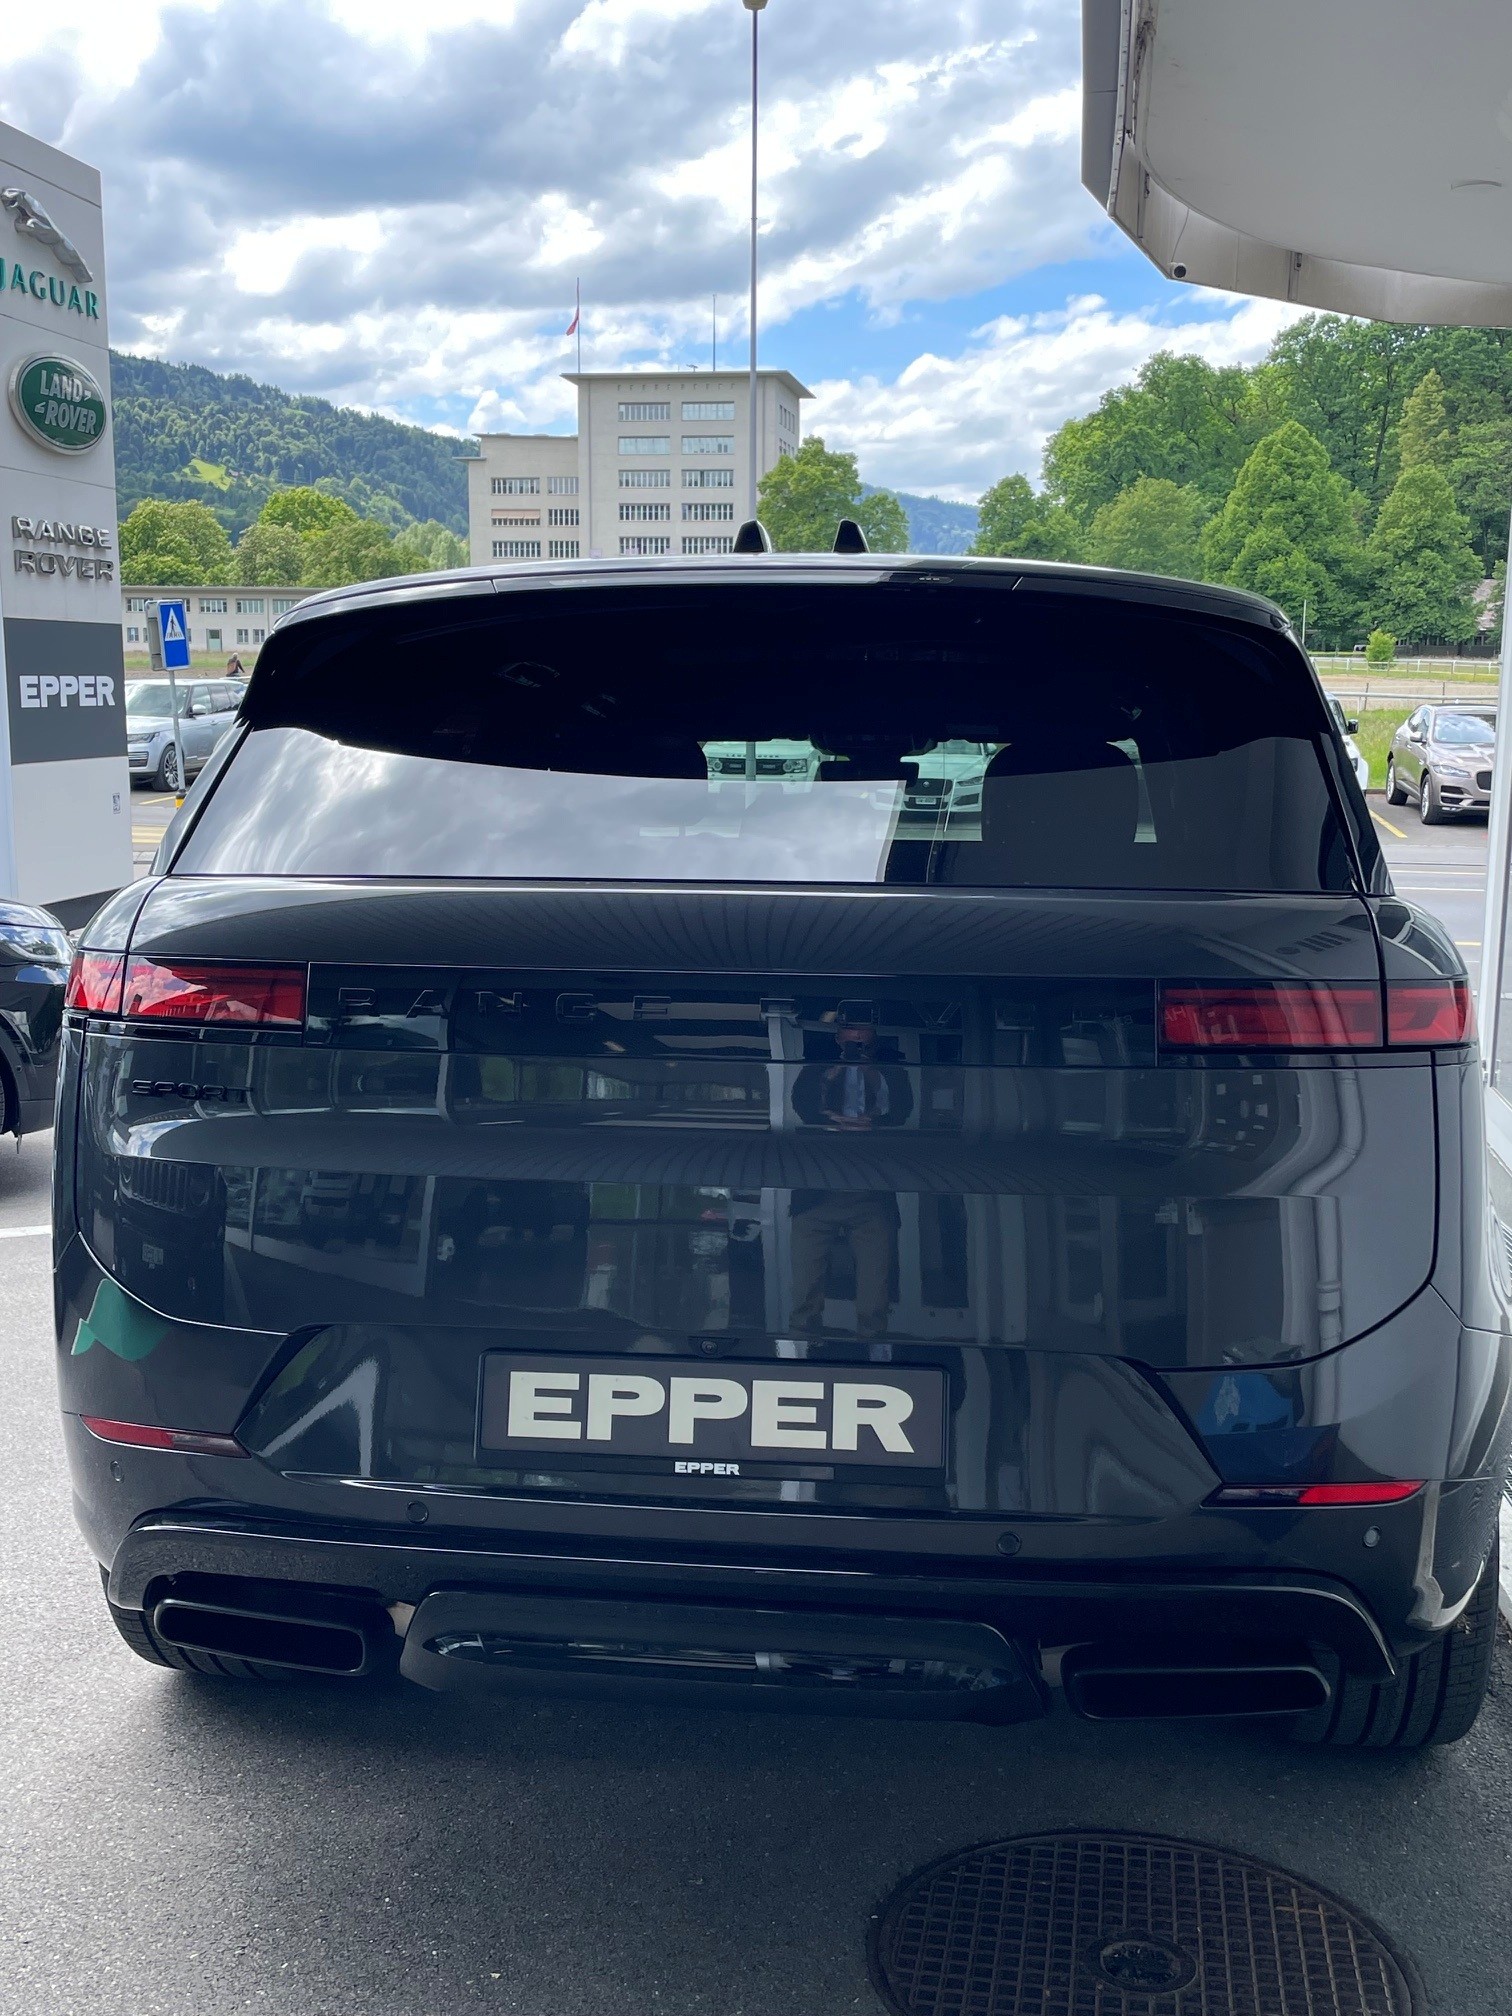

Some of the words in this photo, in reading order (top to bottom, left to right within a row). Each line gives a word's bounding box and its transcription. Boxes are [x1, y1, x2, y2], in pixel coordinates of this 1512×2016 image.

[40, 370, 82, 404] LAND
[44, 400, 97, 436] ROVER
[11, 516, 112, 549] RANGE
[14, 550, 114, 581] ROVER
[19, 675, 116, 708] EPPER
[337, 986, 672, 1022] RANGE
[132, 1079, 253, 1103] SPORT
[507, 1371, 915, 1453] EPPER
[674, 1461, 740, 1475] EPPER
